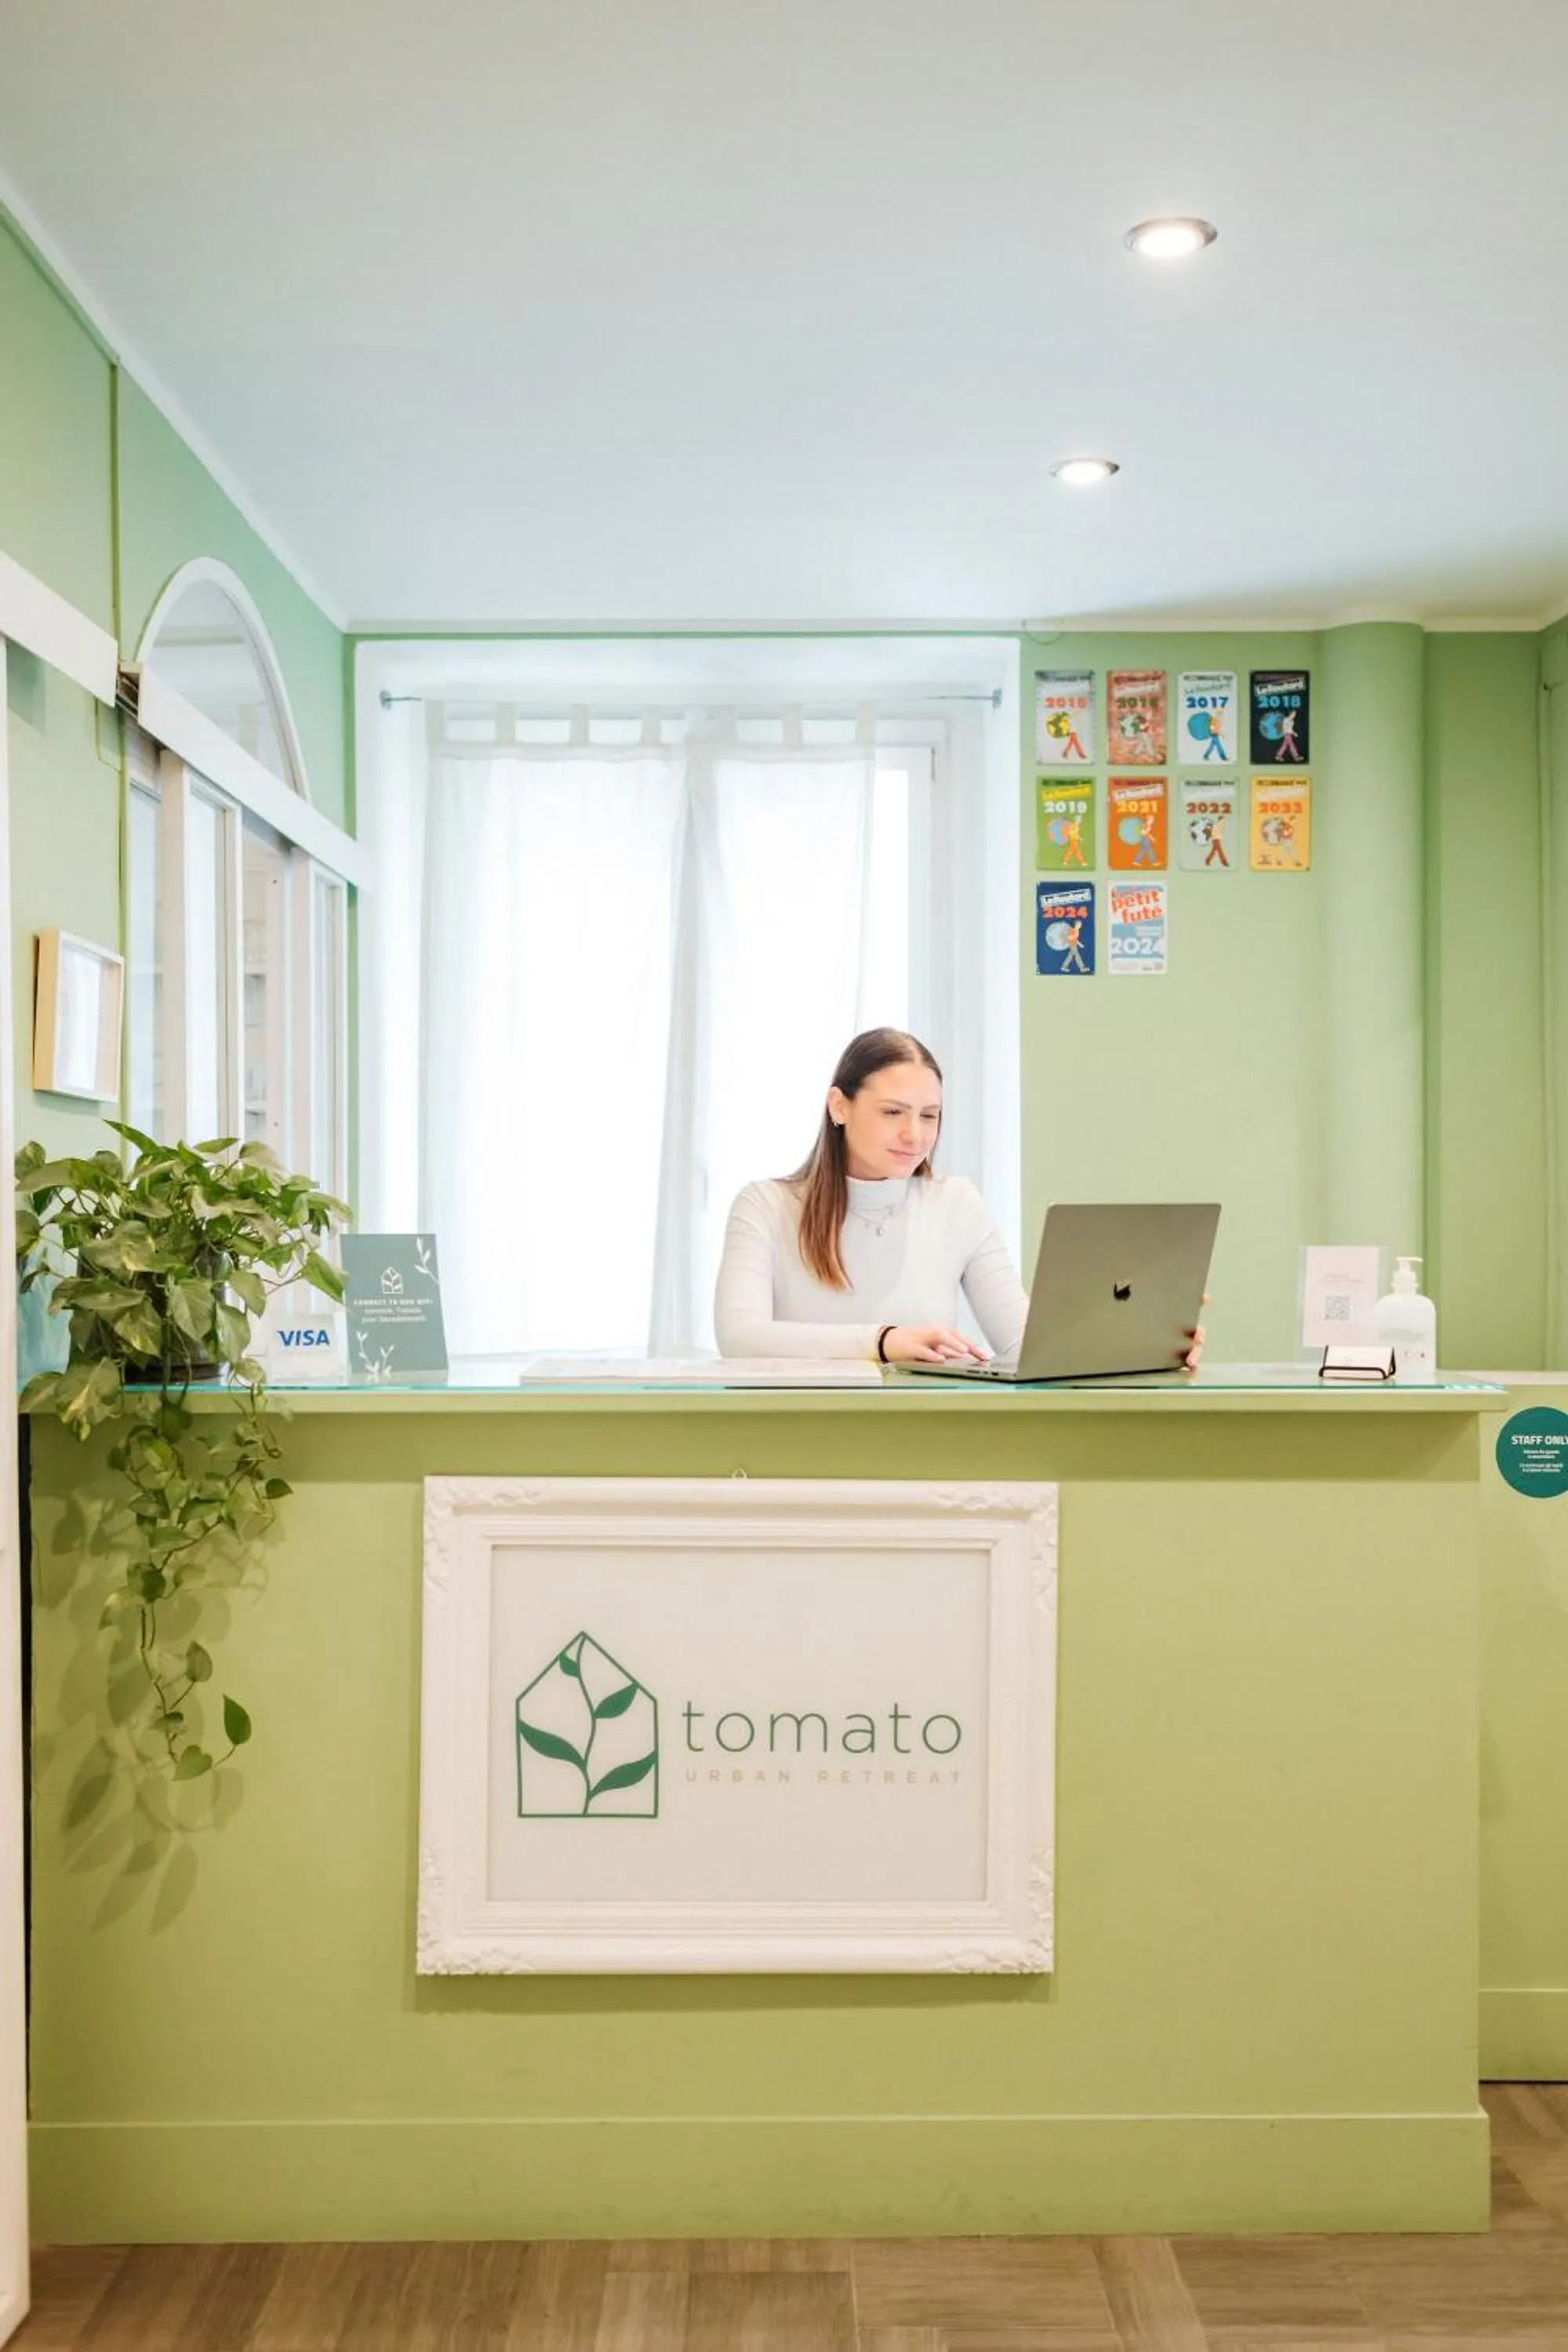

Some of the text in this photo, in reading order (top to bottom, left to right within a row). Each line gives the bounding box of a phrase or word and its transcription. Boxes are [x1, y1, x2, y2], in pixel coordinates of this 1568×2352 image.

[1186, 695, 1229, 708] 2017
[1258, 695, 1301, 708] 2018
[1044, 800, 1087, 813] 2019
[1116, 800, 1158, 813] 2021
[1186, 802, 1232, 814] 2022
[1043, 906, 1088, 919] 2024
[277, 1330, 330, 1346] VISA
[1511, 1436, 1543, 1445] STAFF
[682, 1700, 961, 1755] tomato
[685, 1769, 960, 1784] URBAN RETREAT
